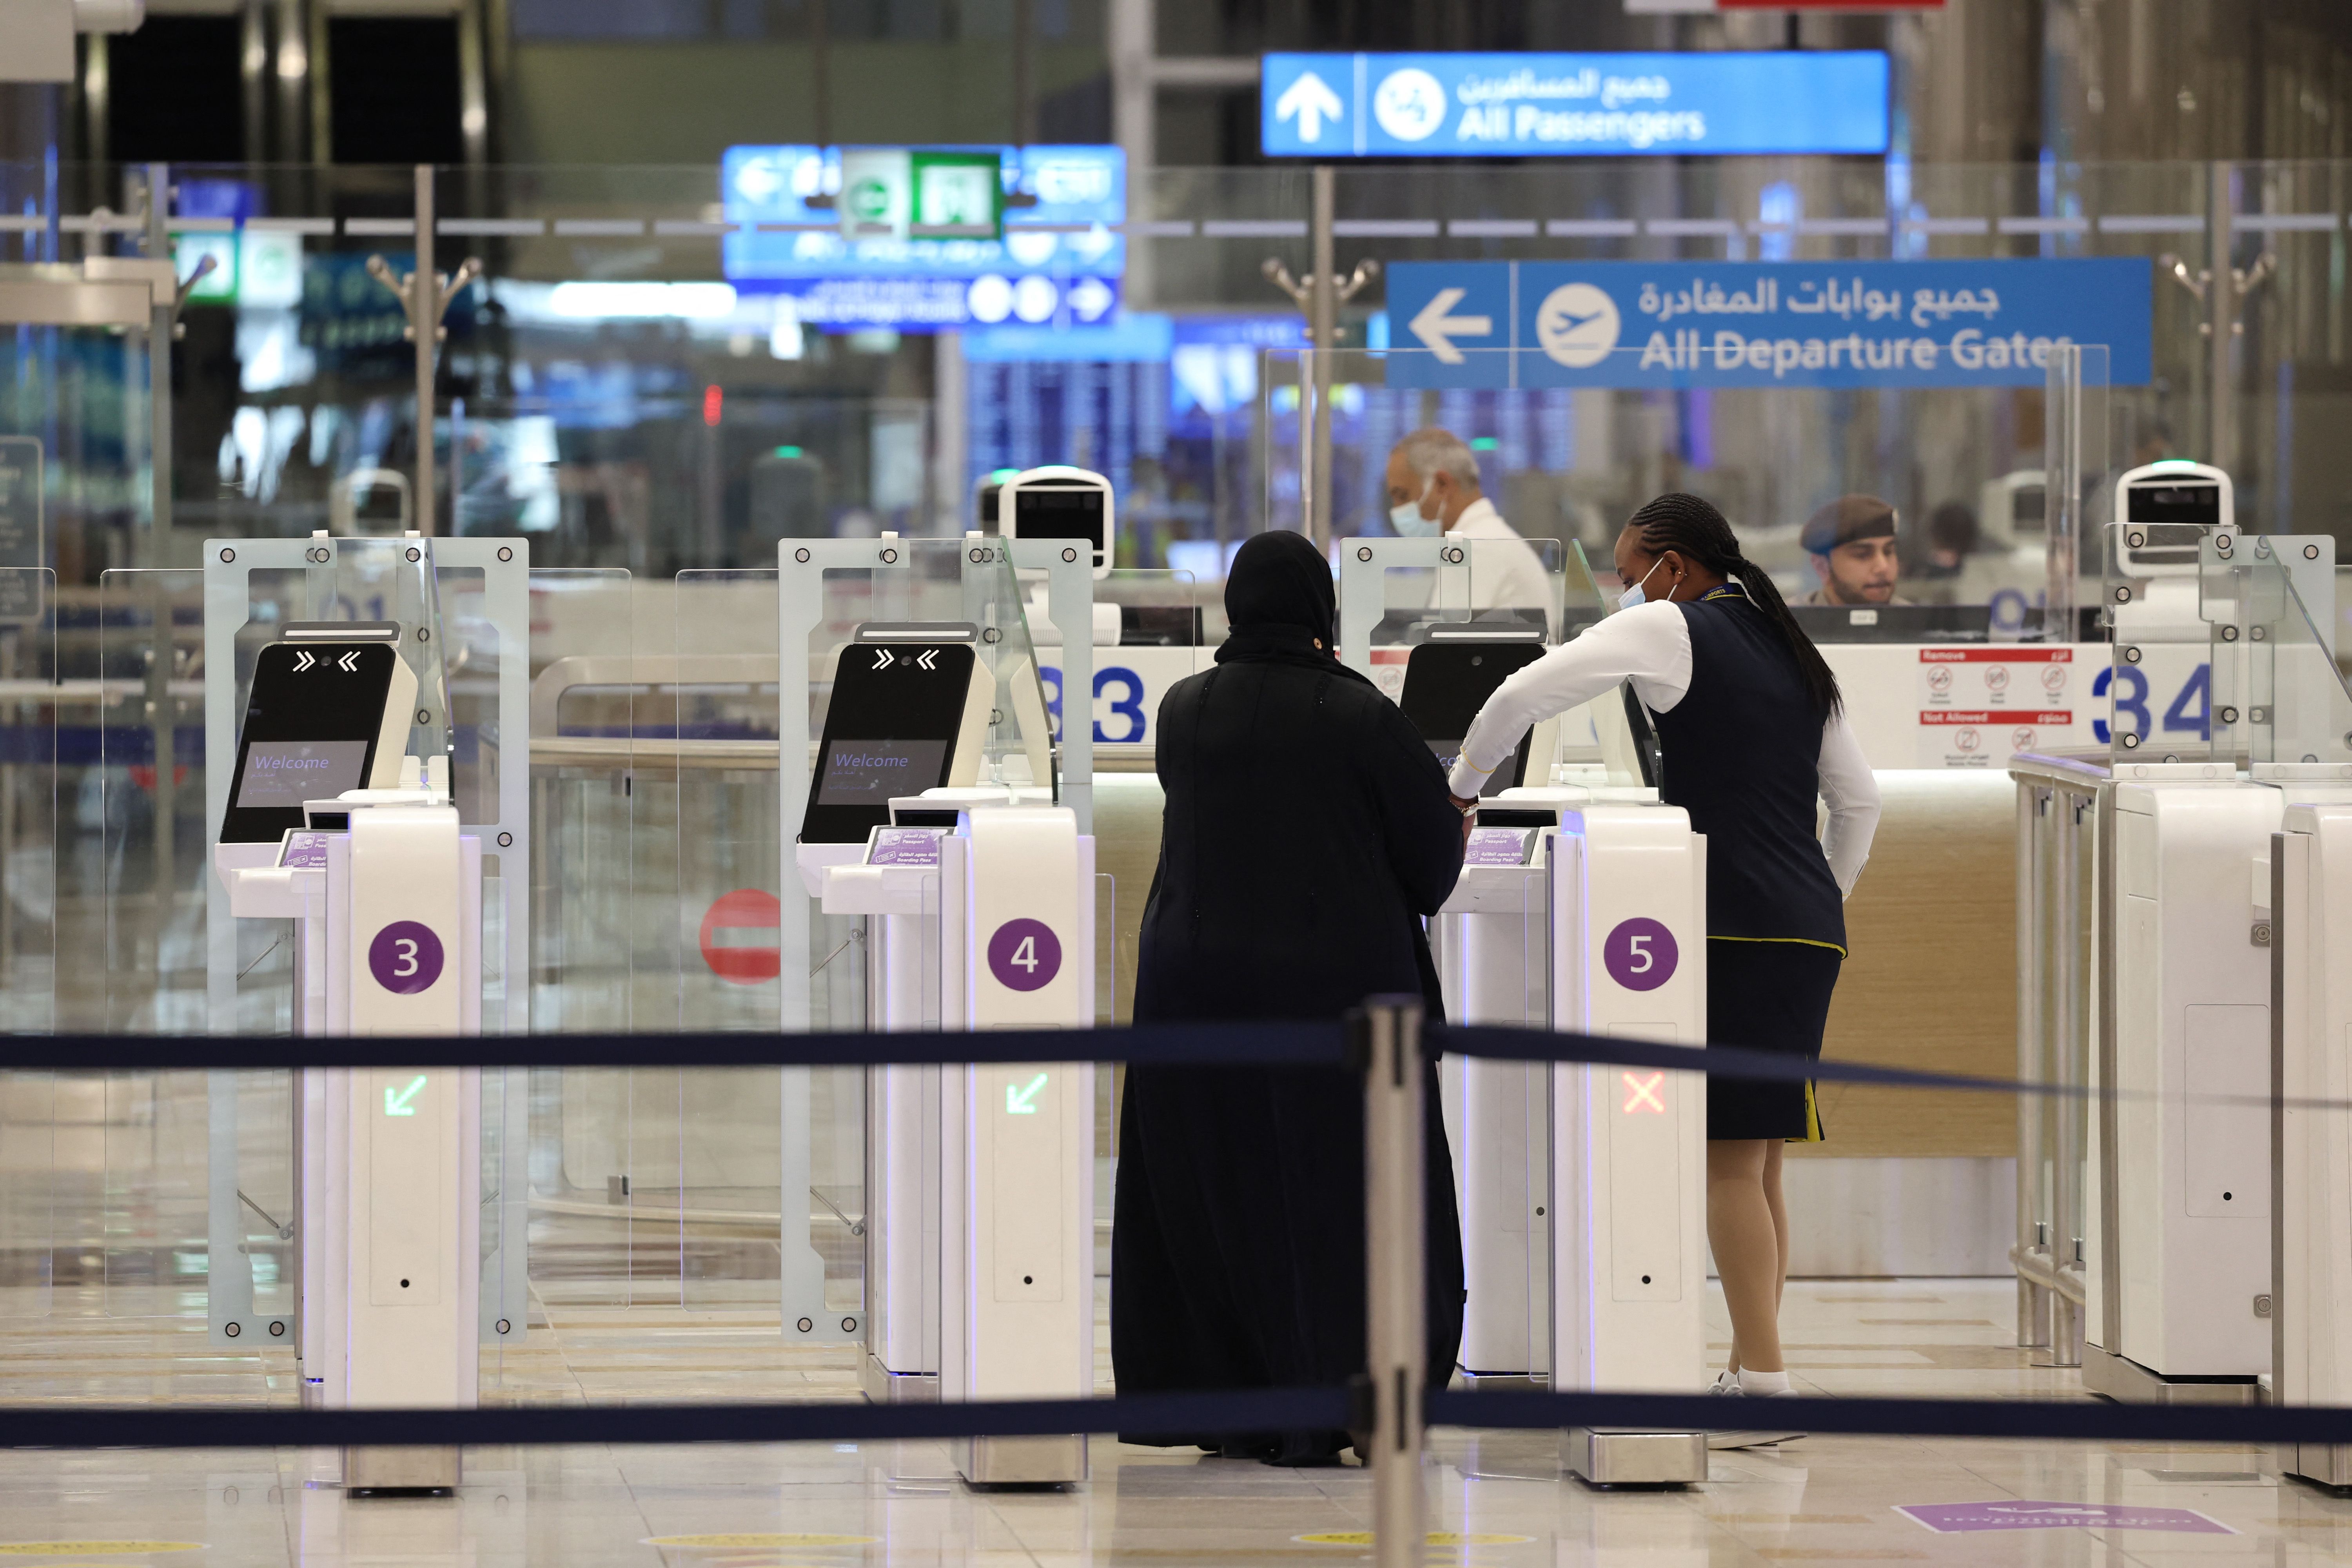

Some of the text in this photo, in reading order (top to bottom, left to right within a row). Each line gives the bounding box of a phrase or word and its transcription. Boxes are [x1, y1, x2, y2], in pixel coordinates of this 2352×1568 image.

[1457, 104, 1706, 149] All Passengers
[1637, 276, 2000, 328] جميع بوابات المغادرة
[1639, 328, 2073, 379] All Departure Gate
[1923, 650, 1965, 660] Remove
[1924, 712, 1988, 722] Not Allowed
[2092, 663, 2227, 743] 34
[256, 755, 329, 769] Welcome
[836, 753, 908, 766] Welcome
[394, 938, 418, 976] 3
[1011, 936, 1038, 973] 4
[1630, 936, 1653, 973] 5
